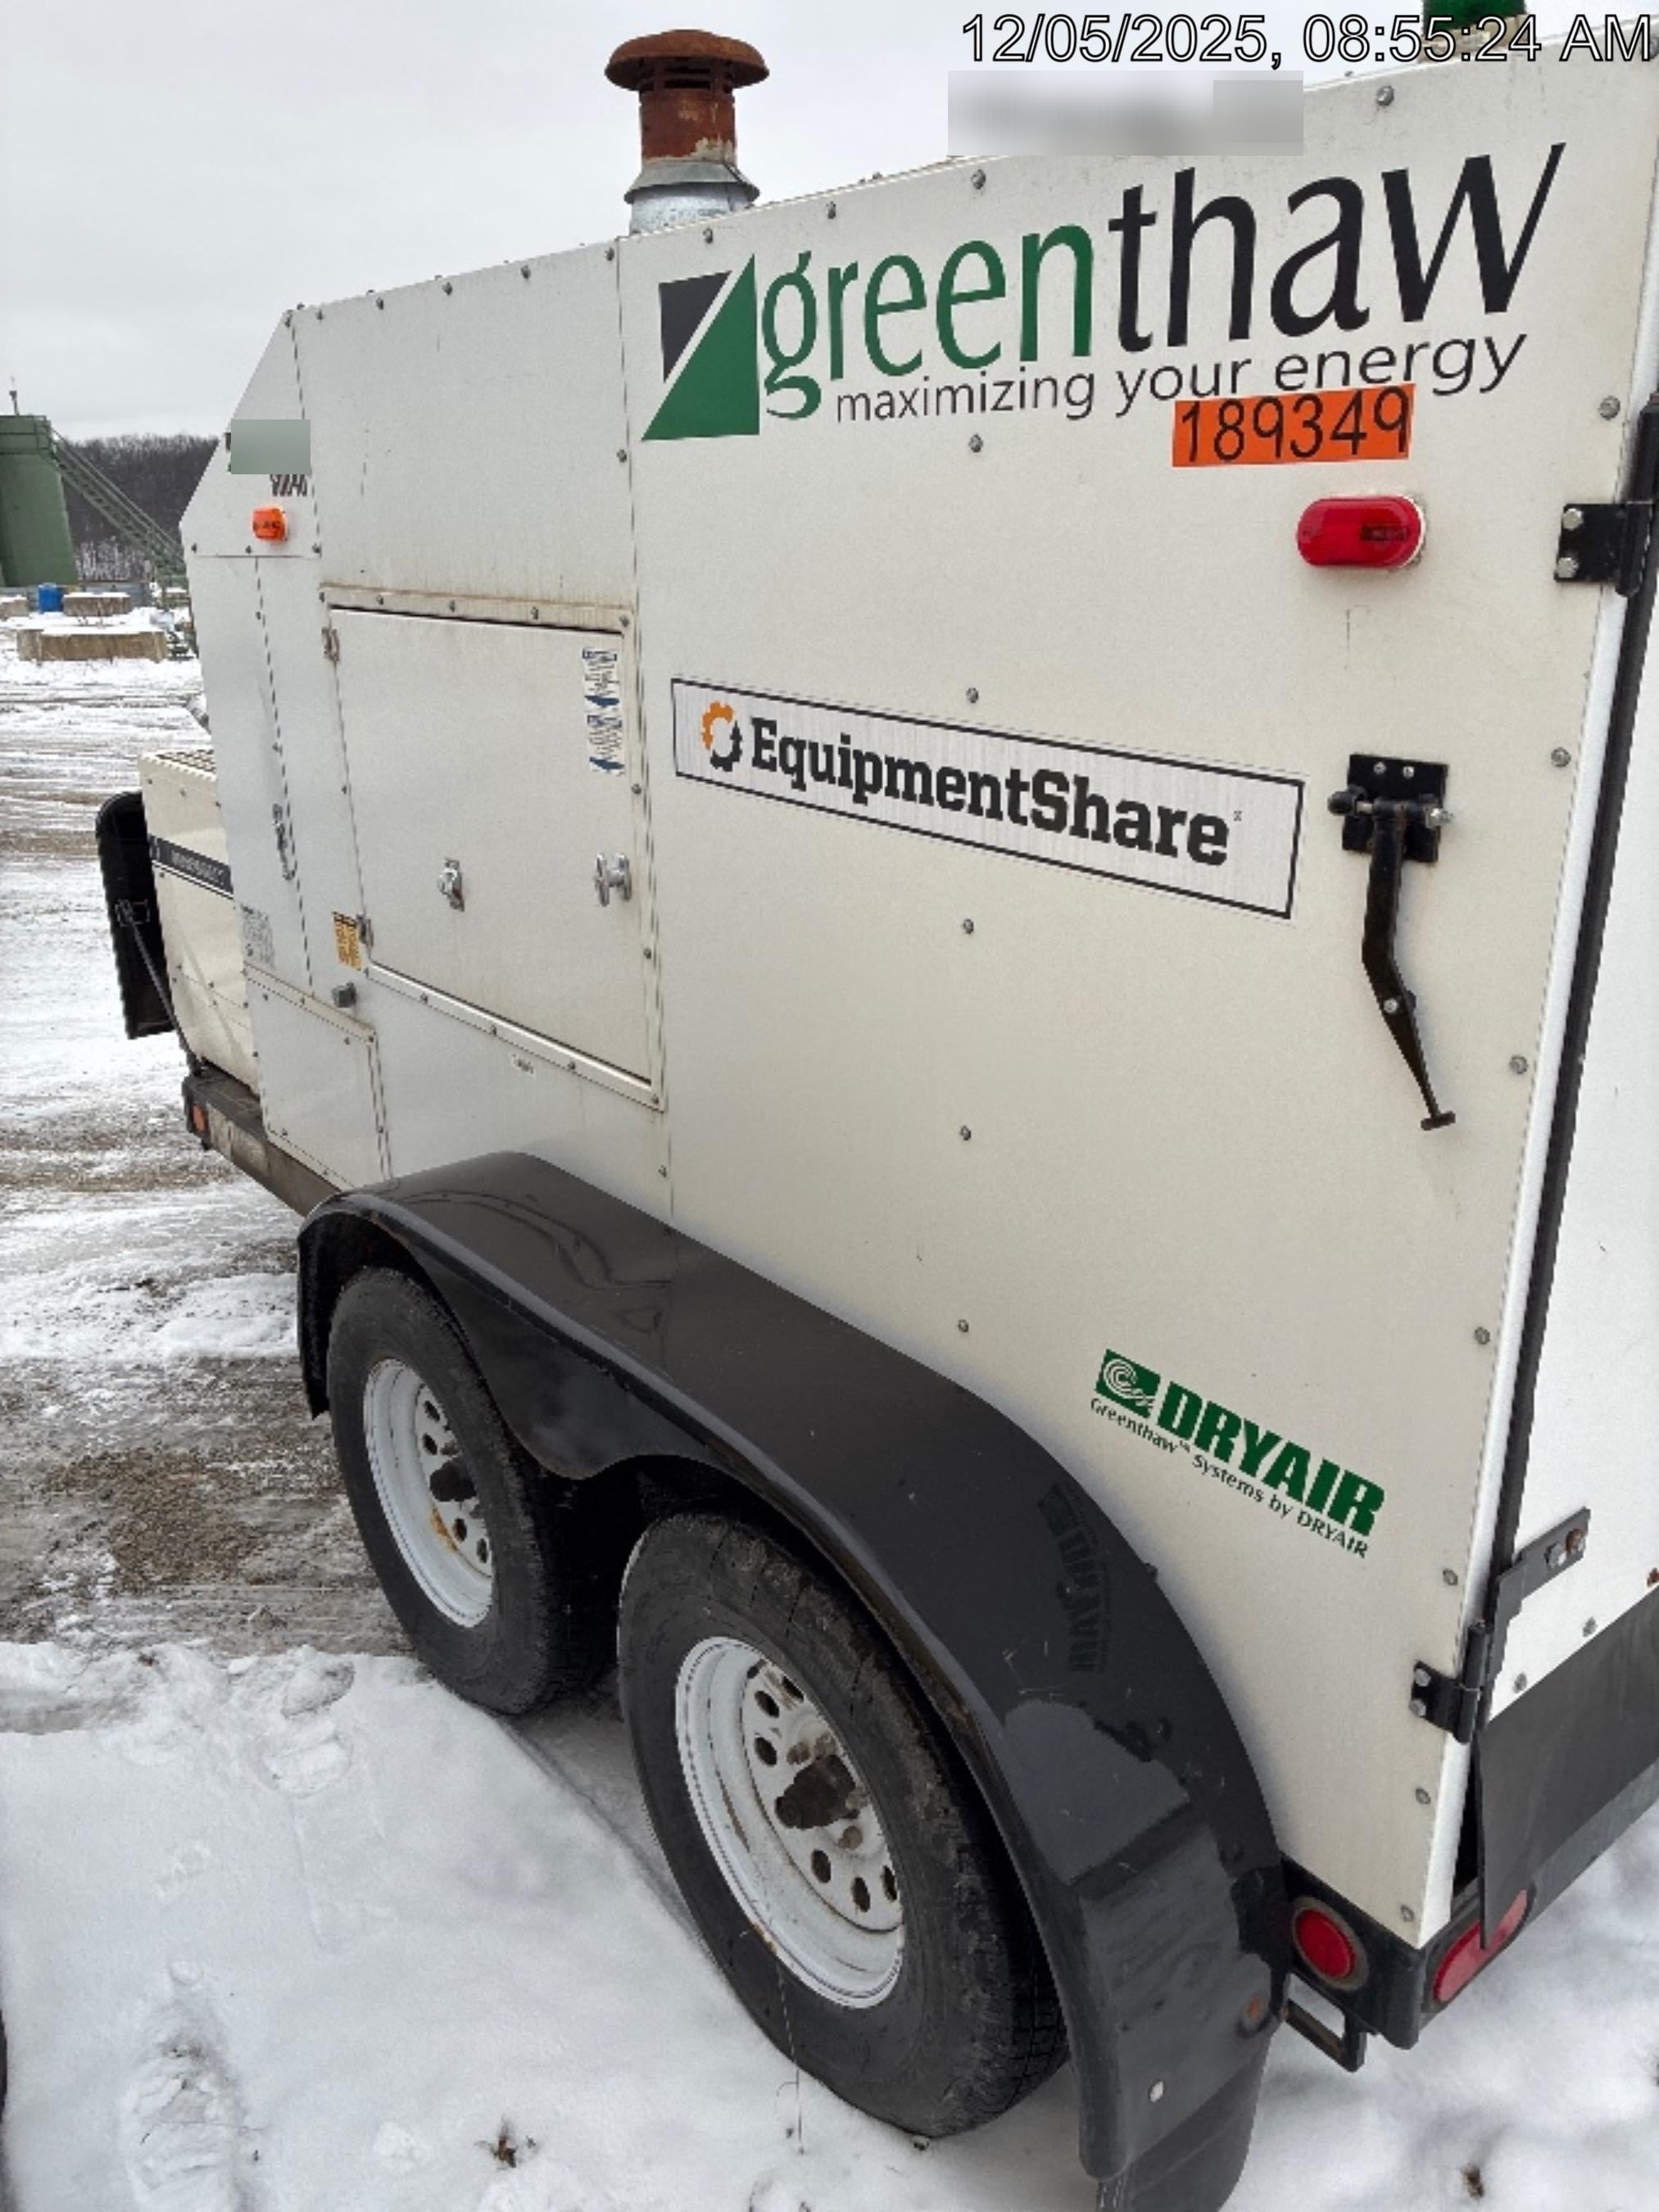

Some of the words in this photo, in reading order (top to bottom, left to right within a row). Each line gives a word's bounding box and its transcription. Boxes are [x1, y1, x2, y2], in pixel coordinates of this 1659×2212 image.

[763, 142, 1566, 421] greenthaw
[836, 370, 1096, 423] maximizing
[1115, 359, 1252, 419] your
[1274, 333, 1527, 397] energy
[1182, 386, 1409, 463] 189349
[1158, 1380, 1385, 1537] DRYAIR
[1192, 1453, 1264, 1503] Systems
[1268, 1494, 1292, 1520] by
[1297, 1509, 1369, 1559] DRYAIR
